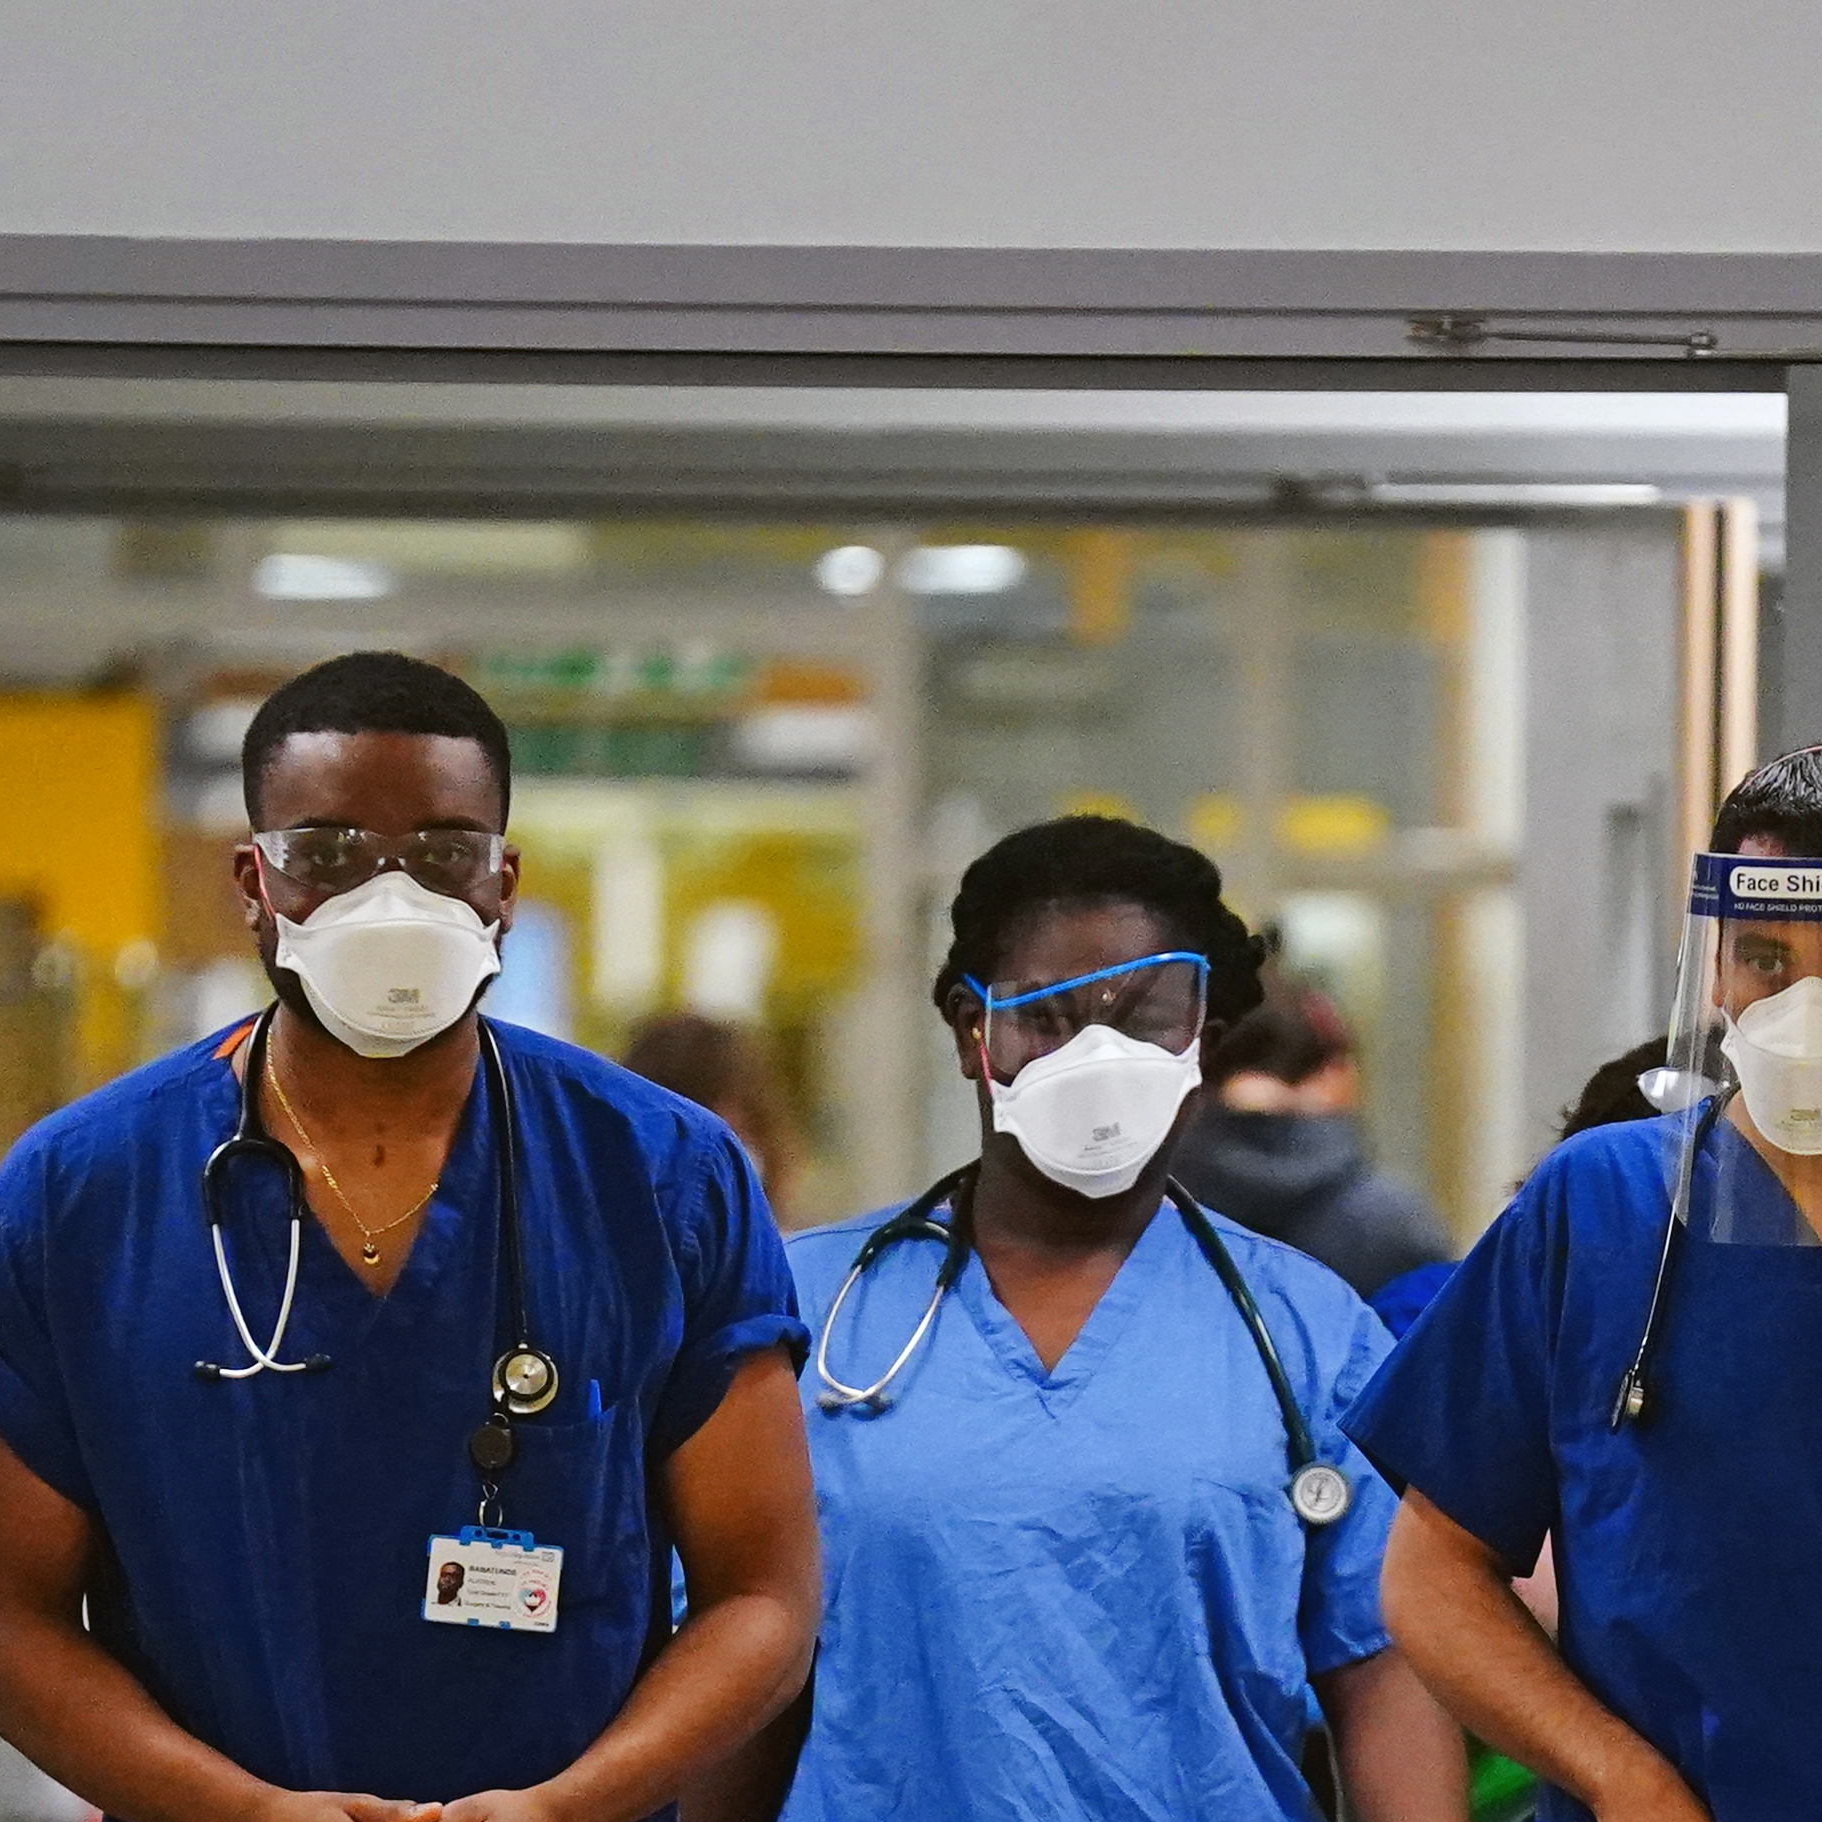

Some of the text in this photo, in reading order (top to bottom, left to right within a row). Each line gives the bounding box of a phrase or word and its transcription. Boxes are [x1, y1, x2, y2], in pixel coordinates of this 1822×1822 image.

[1736, 873, 1779, 891] Face
[1767, 903, 1797, 912] SHIELD
[388, 988, 420, 1003] 3M
[1092, 1122, 1121, 1141] 3M
